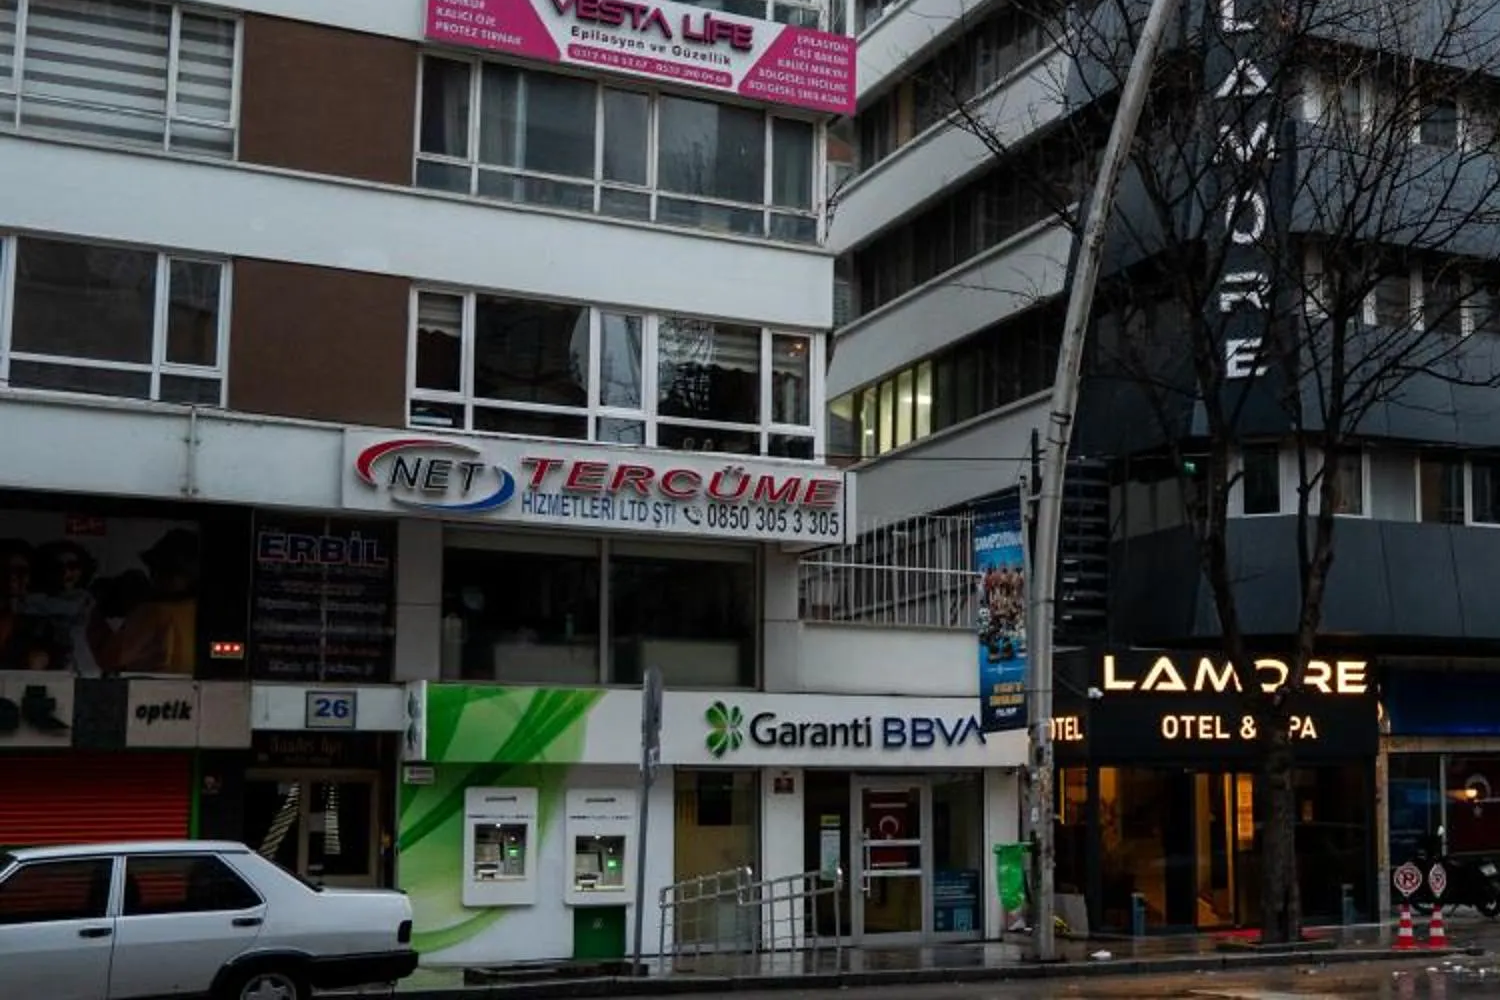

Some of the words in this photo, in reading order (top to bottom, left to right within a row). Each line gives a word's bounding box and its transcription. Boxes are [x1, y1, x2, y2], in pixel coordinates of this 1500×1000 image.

[571, 26, 645, 50] Epilasyon
[650, 43, 667, 54] ve
[672, 45, 732, 66] Güzellik
[681, 11, 754, 53] LİFE
[390, 454, 486, 493] NET
[520, 457, 843, 507] TERCÜME
[620, 499, 648, 523] LTD
[707, 503, 749, 530] 0850
[756, 506, 787, 533] 305
[792, 509, 803, 533] 3
[807, 509, 839, 537] 305
[257, 530, 389, 568] ERBİL
[135, 701, 193, 725] optik
[314, 698, 349, 718] 26
[1162, 715, 1231, 739] OTEL
[1239, 715, 1257, 739] &
[1288, 716, 1318, 739] PA
[749, 711, 873, 749] Garanti
[882, 713, 987, 748] BBVA
